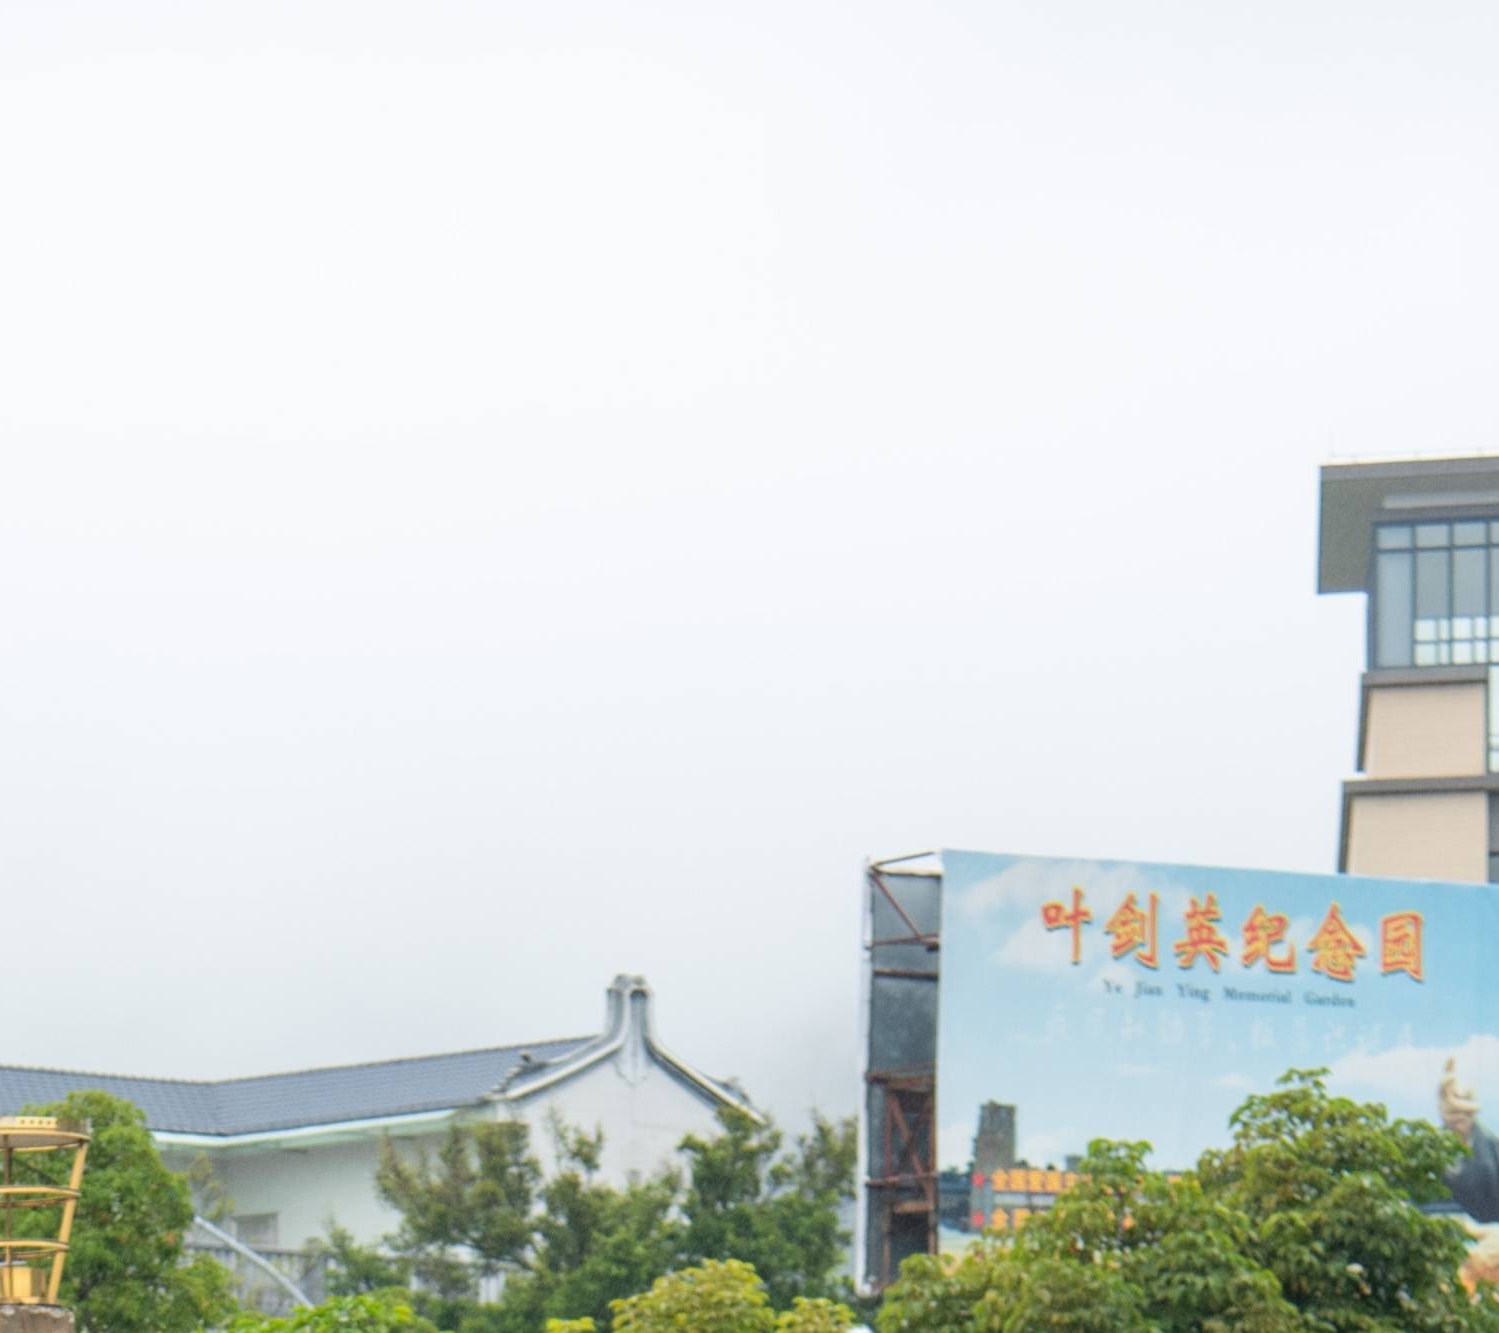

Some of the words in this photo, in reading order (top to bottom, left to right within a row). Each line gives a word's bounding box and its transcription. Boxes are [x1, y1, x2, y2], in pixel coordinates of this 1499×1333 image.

[1041, 888, 1425, 983] 叶剑英纪念园
[1135, 981, 1163, 999] Jian
[1177, 983, 1210, 1003] Ying
[1224, 985, 1292, 1005] Memorial
[1305, 991, 1356, 1008] Garden
